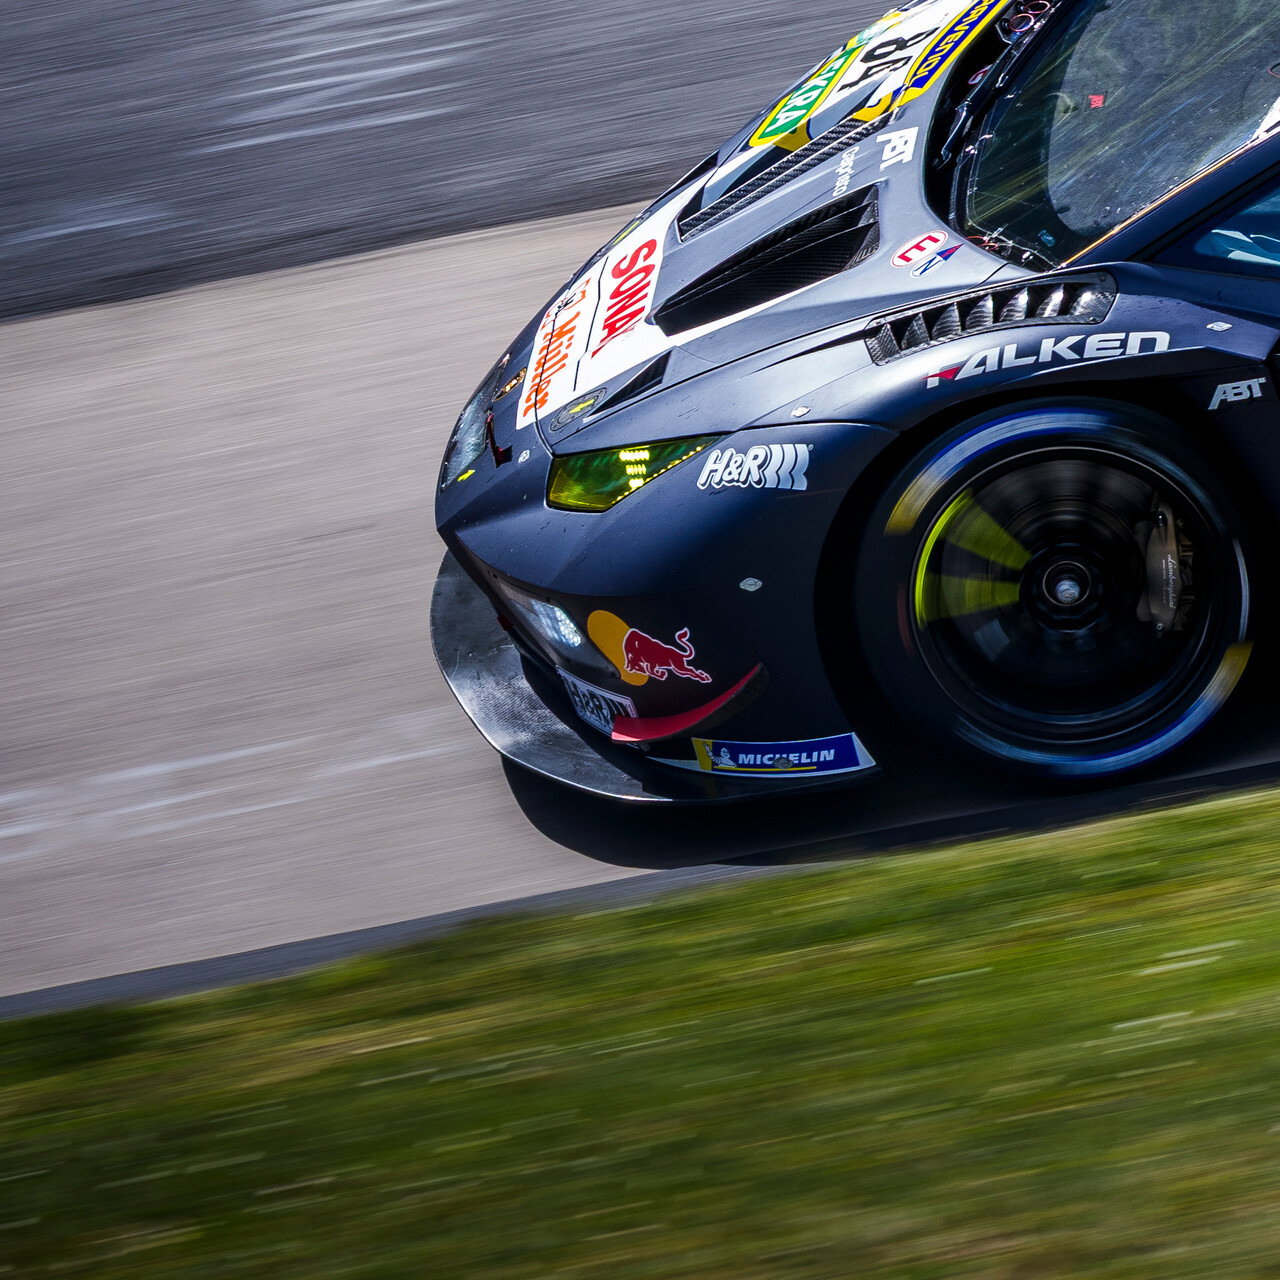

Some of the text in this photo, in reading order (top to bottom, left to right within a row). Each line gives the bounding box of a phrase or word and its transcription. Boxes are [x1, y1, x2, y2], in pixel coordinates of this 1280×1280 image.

[876, 126, 919, 172] ABT
[921, 331, 1170, 389] FALKEN
[1208, 377, 1266, 410] ABT
[697, 445, 770, 489] H&R
